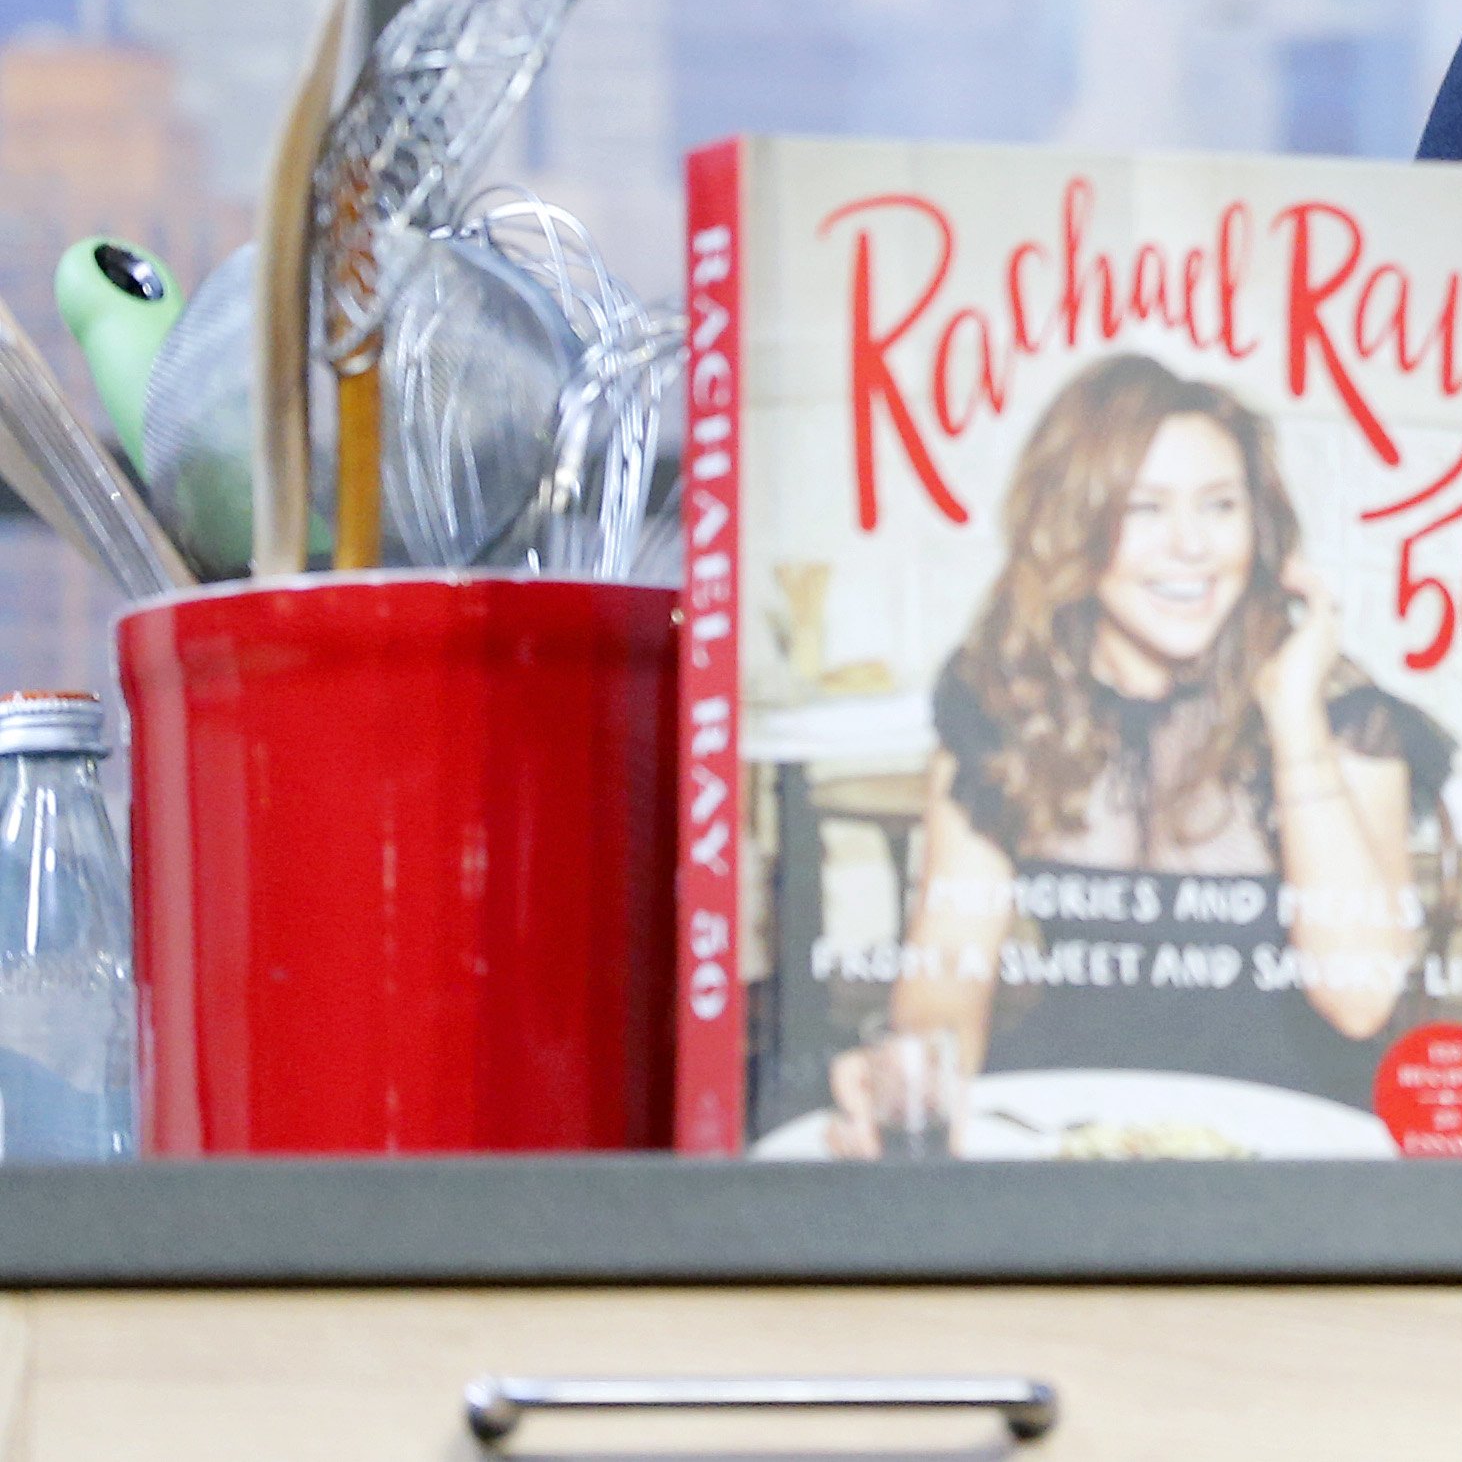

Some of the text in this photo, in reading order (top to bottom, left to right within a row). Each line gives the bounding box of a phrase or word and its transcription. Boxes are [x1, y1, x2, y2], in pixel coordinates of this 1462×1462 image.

[817, 174, 1262, 531] Rachael
[691, 224, 732, 668] RACHAEL
[690, 695, 731, 876] RAY
[1001, 938, 1144, 987] SWEET
[1150, 942, 1243, 989] AND
[1172, 876, 1268, 926] AND
